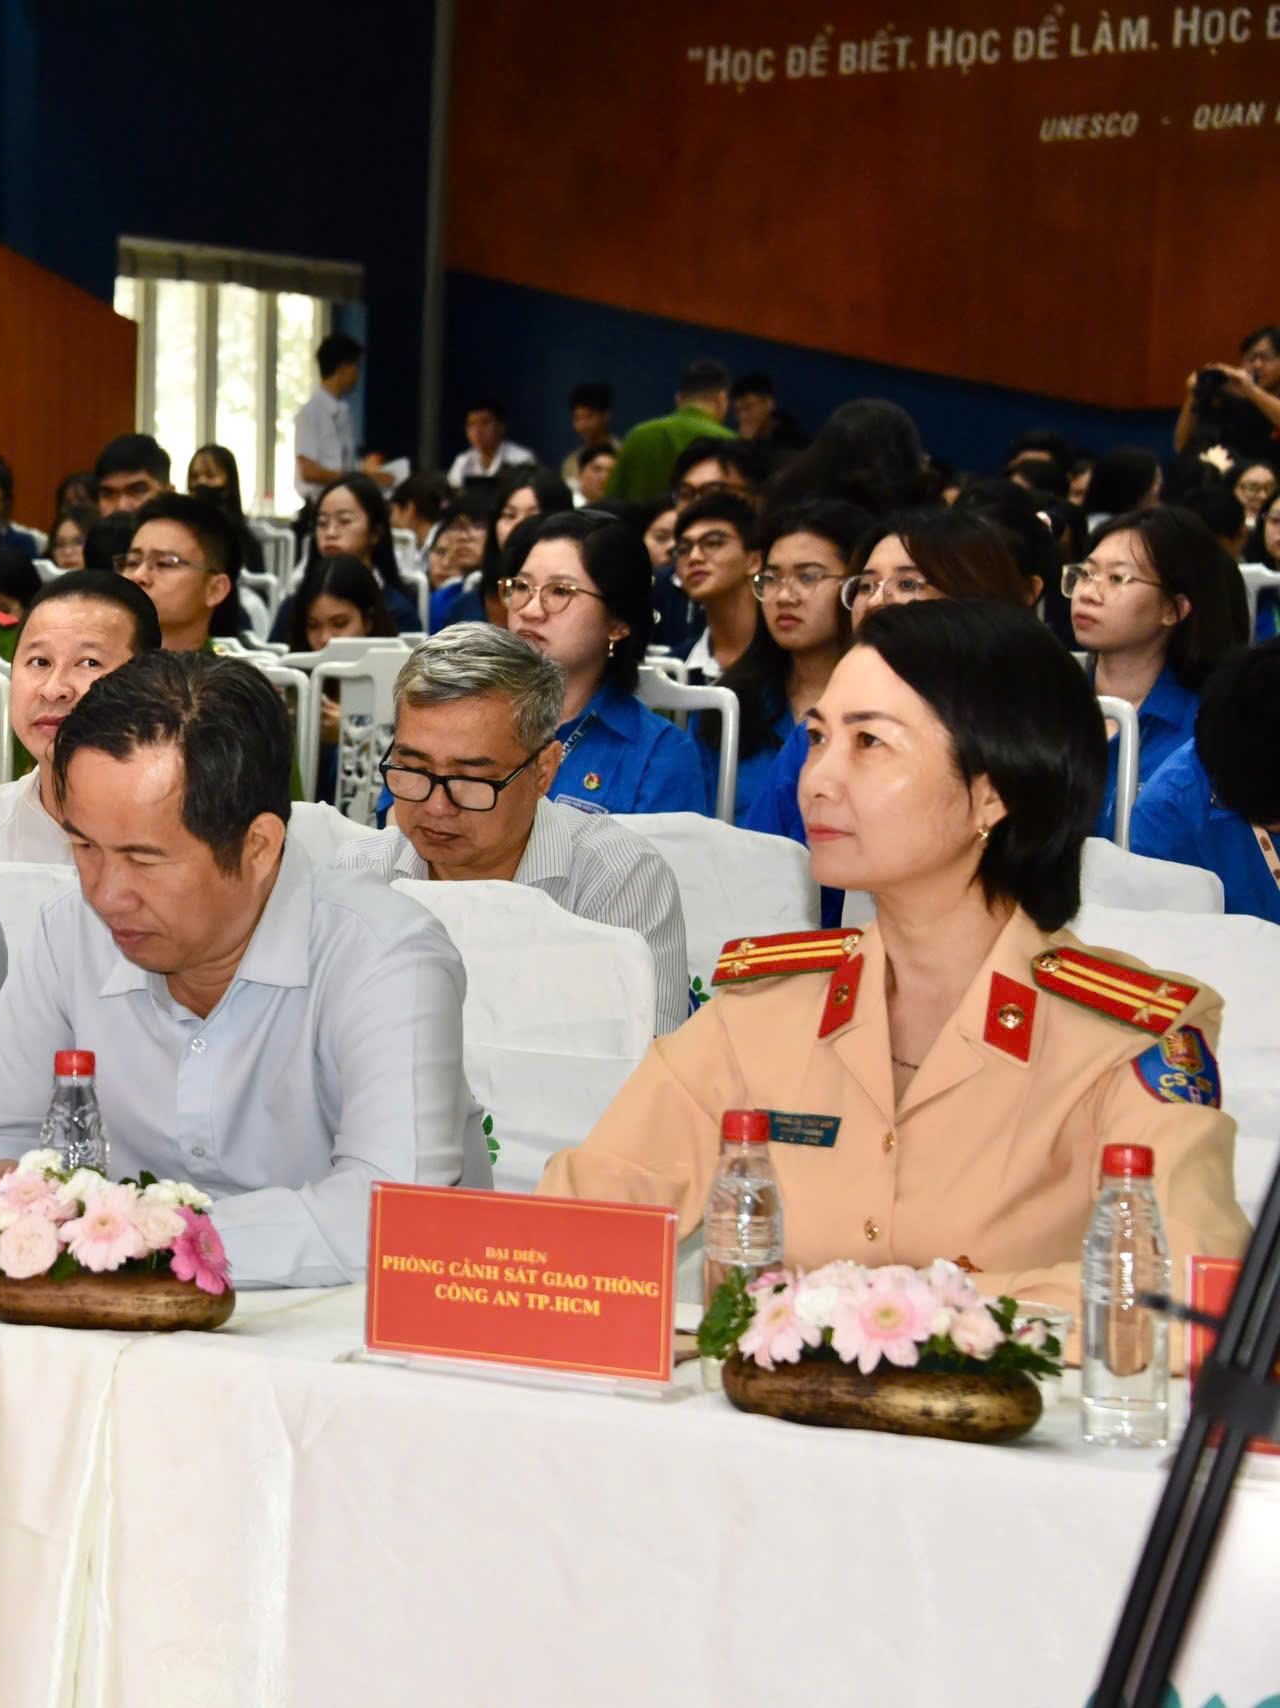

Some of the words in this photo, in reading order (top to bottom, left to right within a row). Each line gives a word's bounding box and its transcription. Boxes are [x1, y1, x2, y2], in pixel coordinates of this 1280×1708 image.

[927, 26, 1000, 74] HỌC
[1070, 10, 1158, 57] LÀM.
[1173, 5, 1252, 56] HỌC
[1040, 111, 1139, 142] UNESCO
[1193, 101, 1266, 131] QUAN
[485, 1246, 510, 1261] ĐẠI
[512, 1248, 547, 1264] DIỆN
[382, 1255, 445, 1274] PHÒNG
[449, 1257, 499, 1280] CẢNH
[504, 1265, 537, 1285] SÁT
[542, 1271, 588, 1290] GIAO
[592, 1275, 660, 1297] THÔNG
[435, 1282, 488, 1304] CÔNG
[493, 1290, 519, 1307] AN
[524, 1293, 600, 1316] TP.HCM
